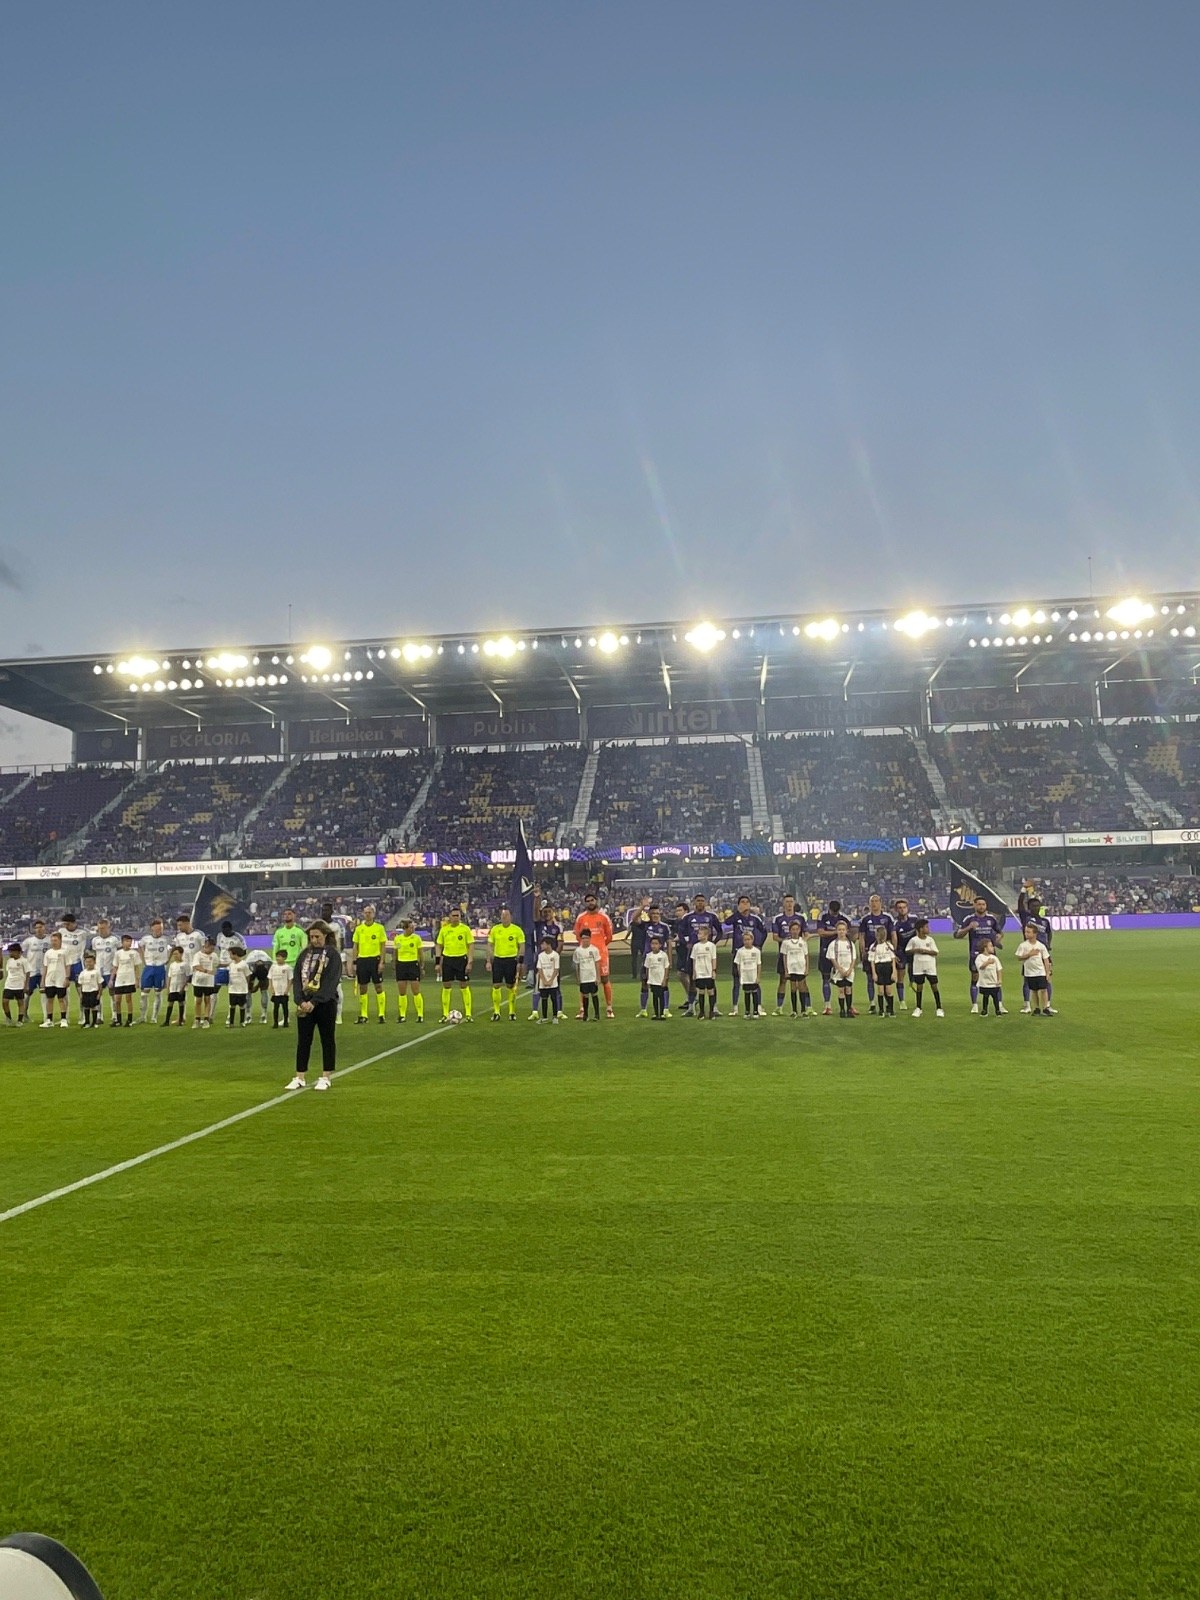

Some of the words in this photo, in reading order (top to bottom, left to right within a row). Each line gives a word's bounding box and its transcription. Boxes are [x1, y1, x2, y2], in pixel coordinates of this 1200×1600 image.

[646, 706, 722, 733] inter
[473, 719, 538, 737] Publix
[169, 731, 251, 748] EXPLORIA
[309, 728, 384, 744] Heineken
[1010, 836, 1043, 847] inter
[1068, 836, 1101, 845] Heineken
[1116, 835, 1147, 844] SILVER
[533, 848, 555, 862] CITY
[652, 846, 682, 857] JAMESON
[330, 857, 358, 868] inter
[40, 868, 61, 878] Ford
[101, 865, 138, 876] Publix
